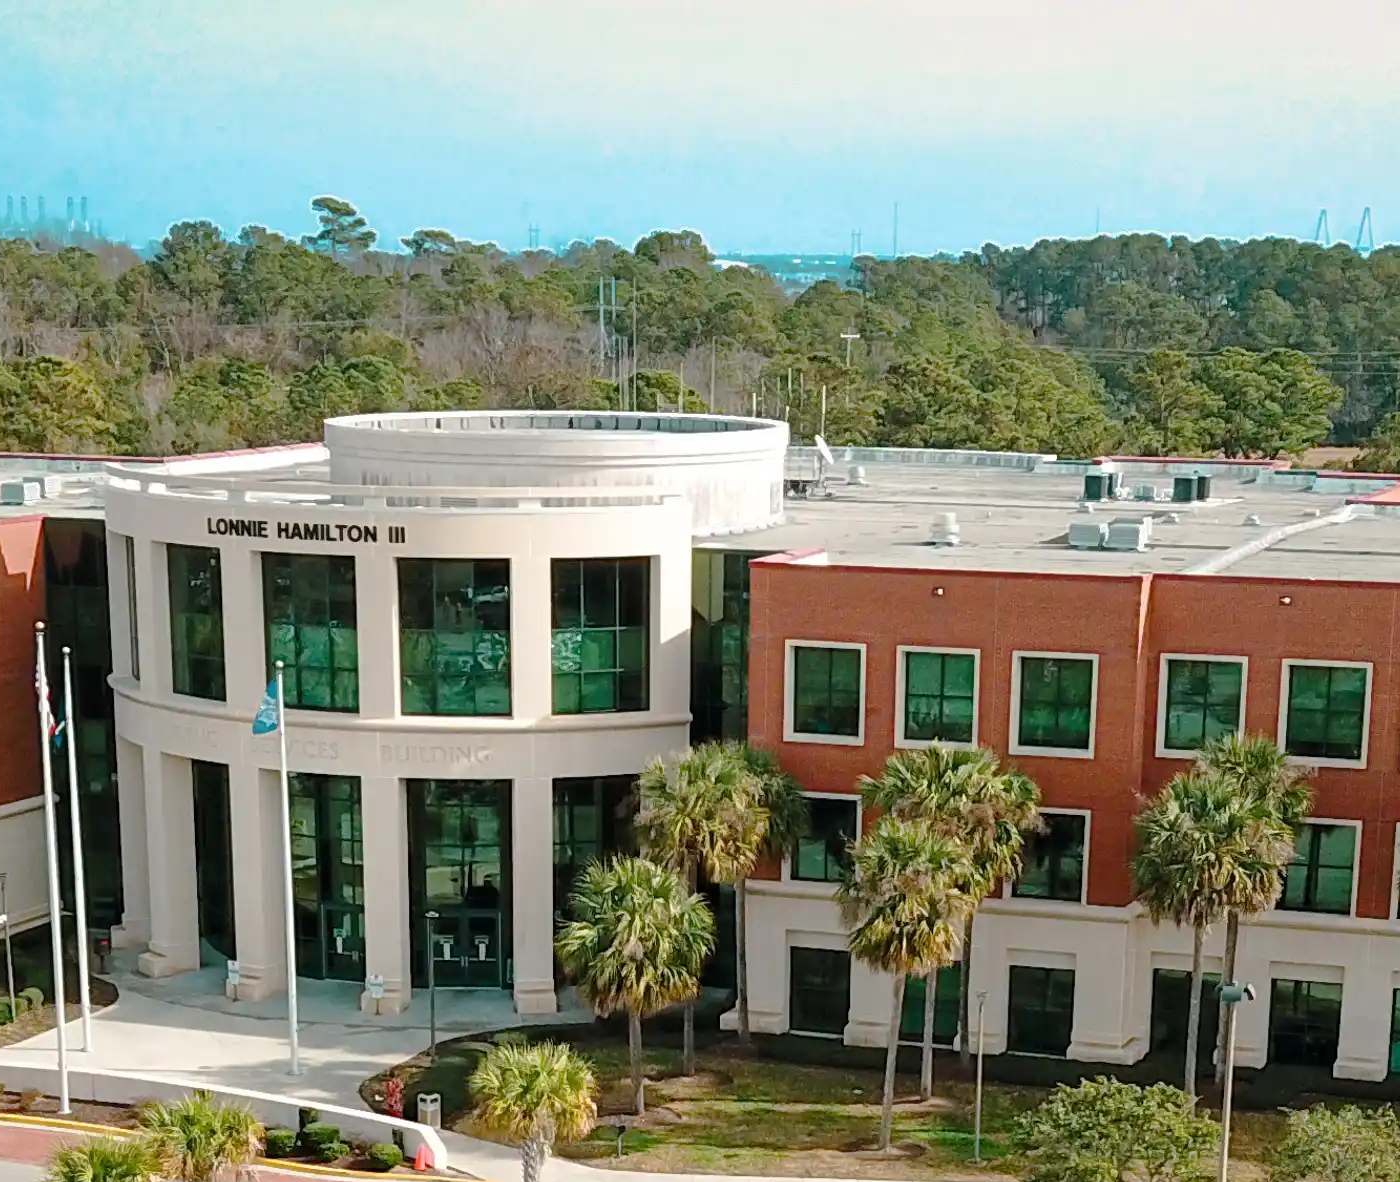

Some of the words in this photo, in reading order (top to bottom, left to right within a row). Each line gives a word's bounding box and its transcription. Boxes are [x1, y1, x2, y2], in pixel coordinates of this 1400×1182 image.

[207, 518, 268, 538] LONNIE
[277, 522, 378, 543] HAMILTON
[388, 525, 406, 544] III
[379, 744, 492, 764] BUILDING
